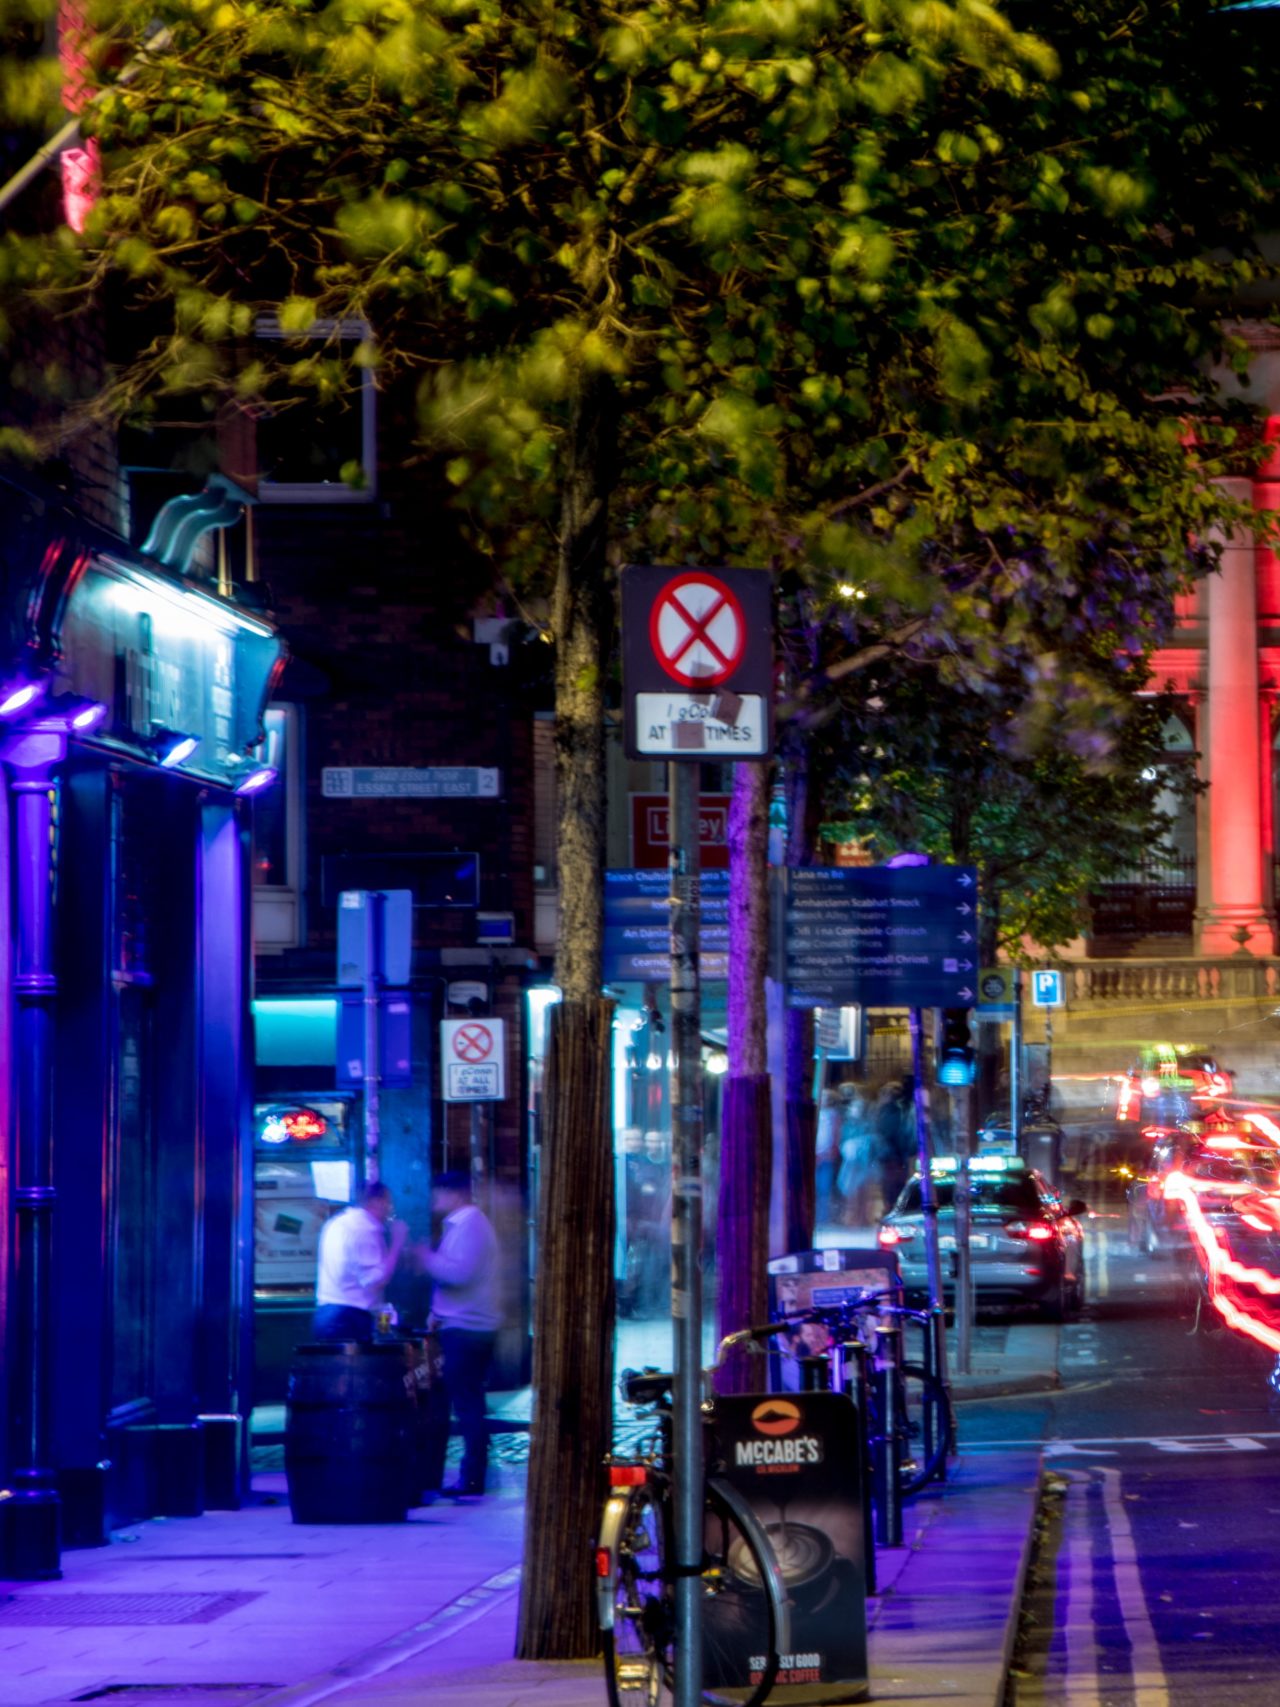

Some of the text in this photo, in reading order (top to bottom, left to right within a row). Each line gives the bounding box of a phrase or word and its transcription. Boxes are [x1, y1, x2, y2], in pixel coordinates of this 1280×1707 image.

[649, 725, 751, 741] AT TIMES
[357, 783, 472, 793] ESSEX STREET EAST
[482, 774, 494, 790] 2
[1039, 973, 1055, 993] P
[795, 1652, 820, 1668] GOOD
